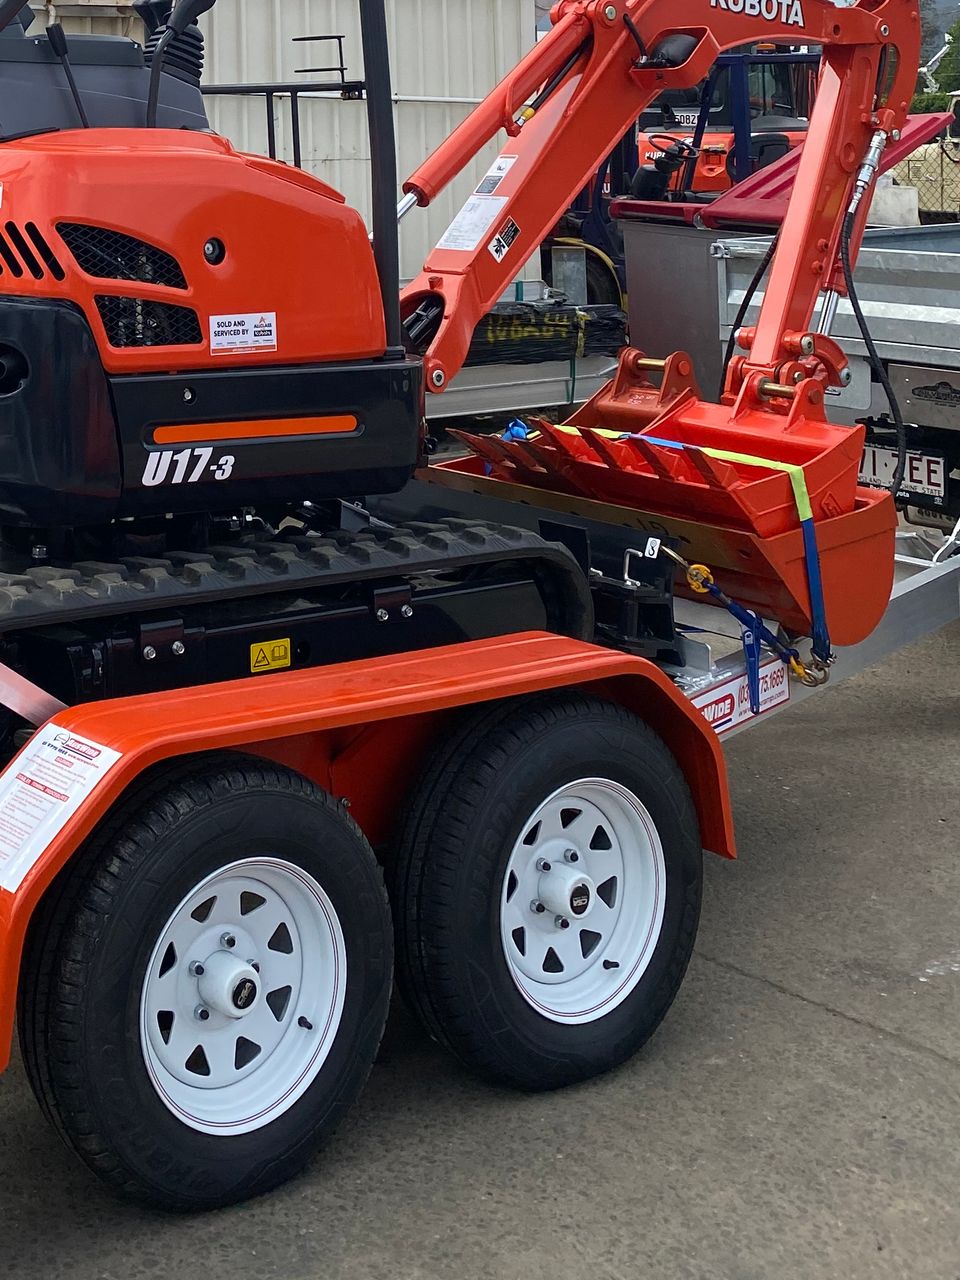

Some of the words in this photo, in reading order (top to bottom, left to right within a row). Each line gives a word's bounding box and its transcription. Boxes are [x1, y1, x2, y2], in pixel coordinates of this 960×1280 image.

[213, 329, 241, 337] SERVICED
[241, 328, 249, 336] BY
[141, 446, 235, 488] U17-3
